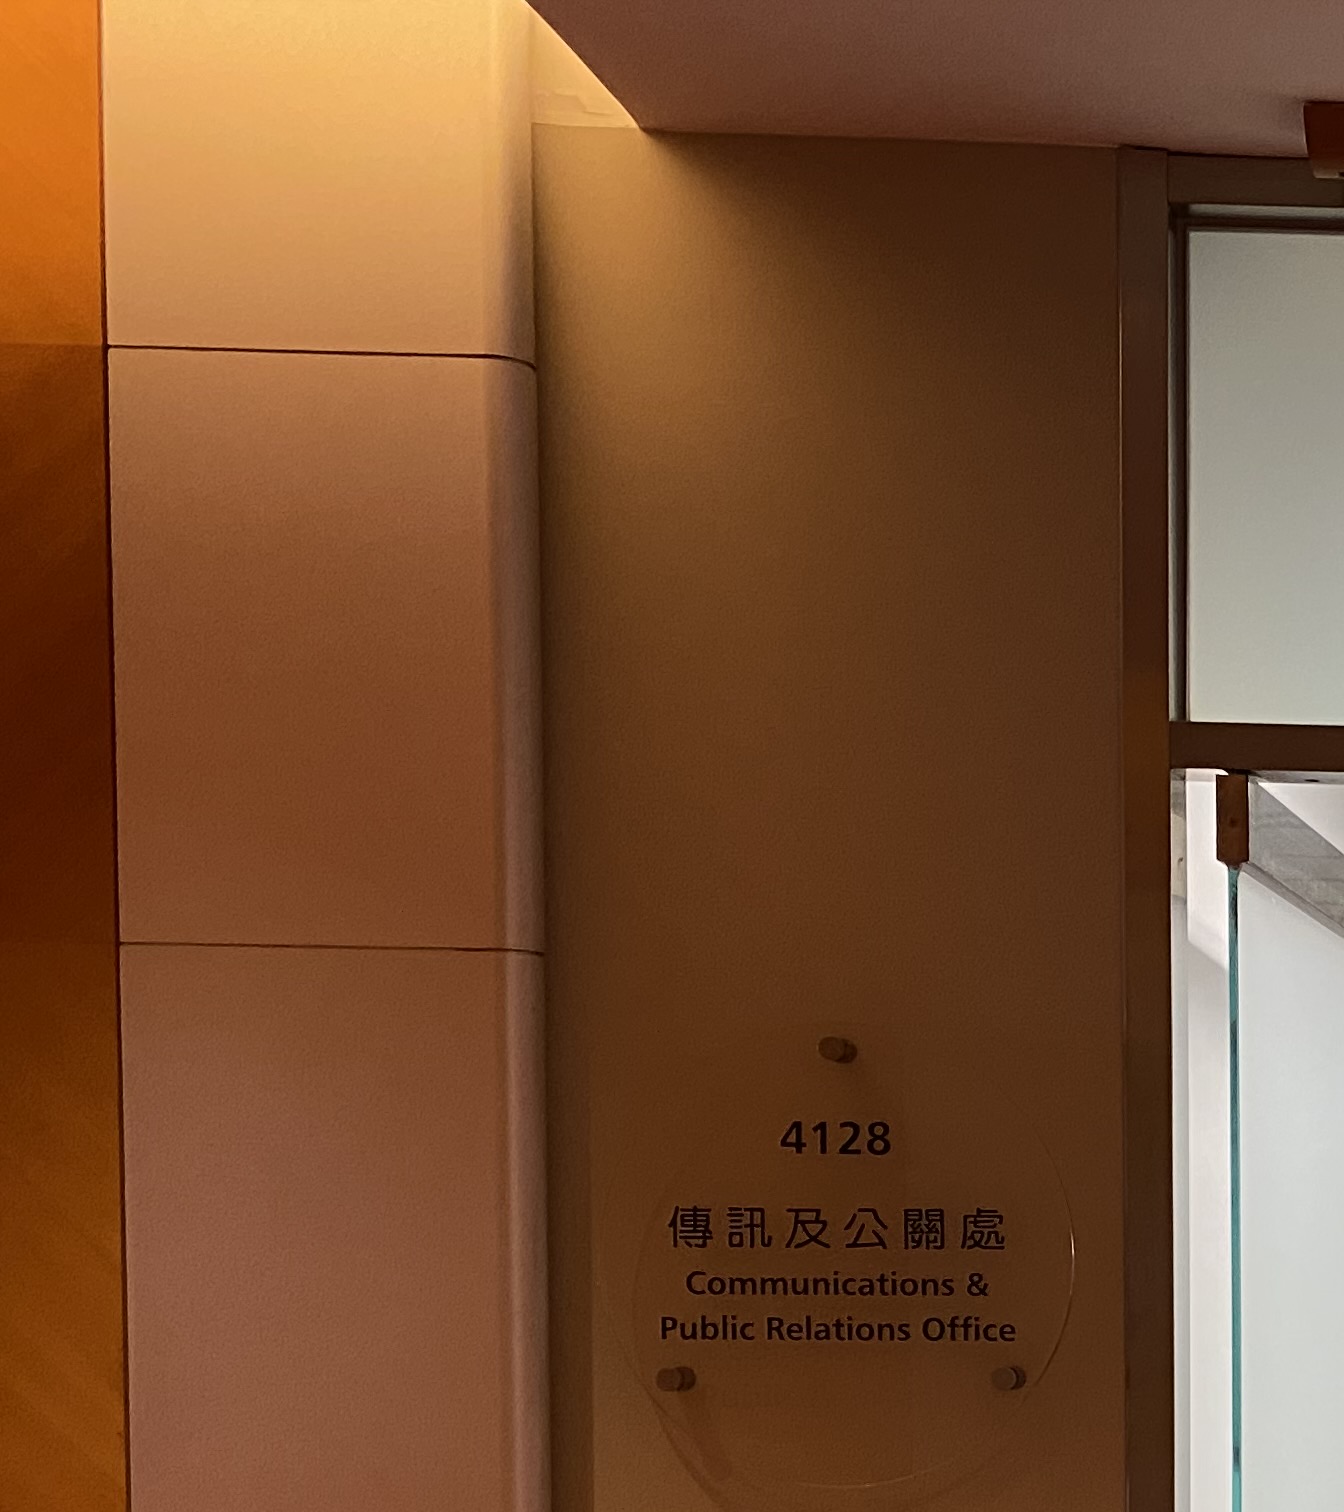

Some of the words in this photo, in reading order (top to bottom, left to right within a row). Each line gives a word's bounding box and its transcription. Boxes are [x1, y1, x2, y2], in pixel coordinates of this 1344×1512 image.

[780, 1120, 892, 1156] 4128
[667, 1204, 1006, 1251] 傳訊及公關處
[685, 1270, 955, 1298] Communications
[966, 1272, 990, 1297] &
[661, 1314, 756, 1341] Public
[766, 1314, 912, 1342] Relations
[921, 1315, 1017, 1342] Office
